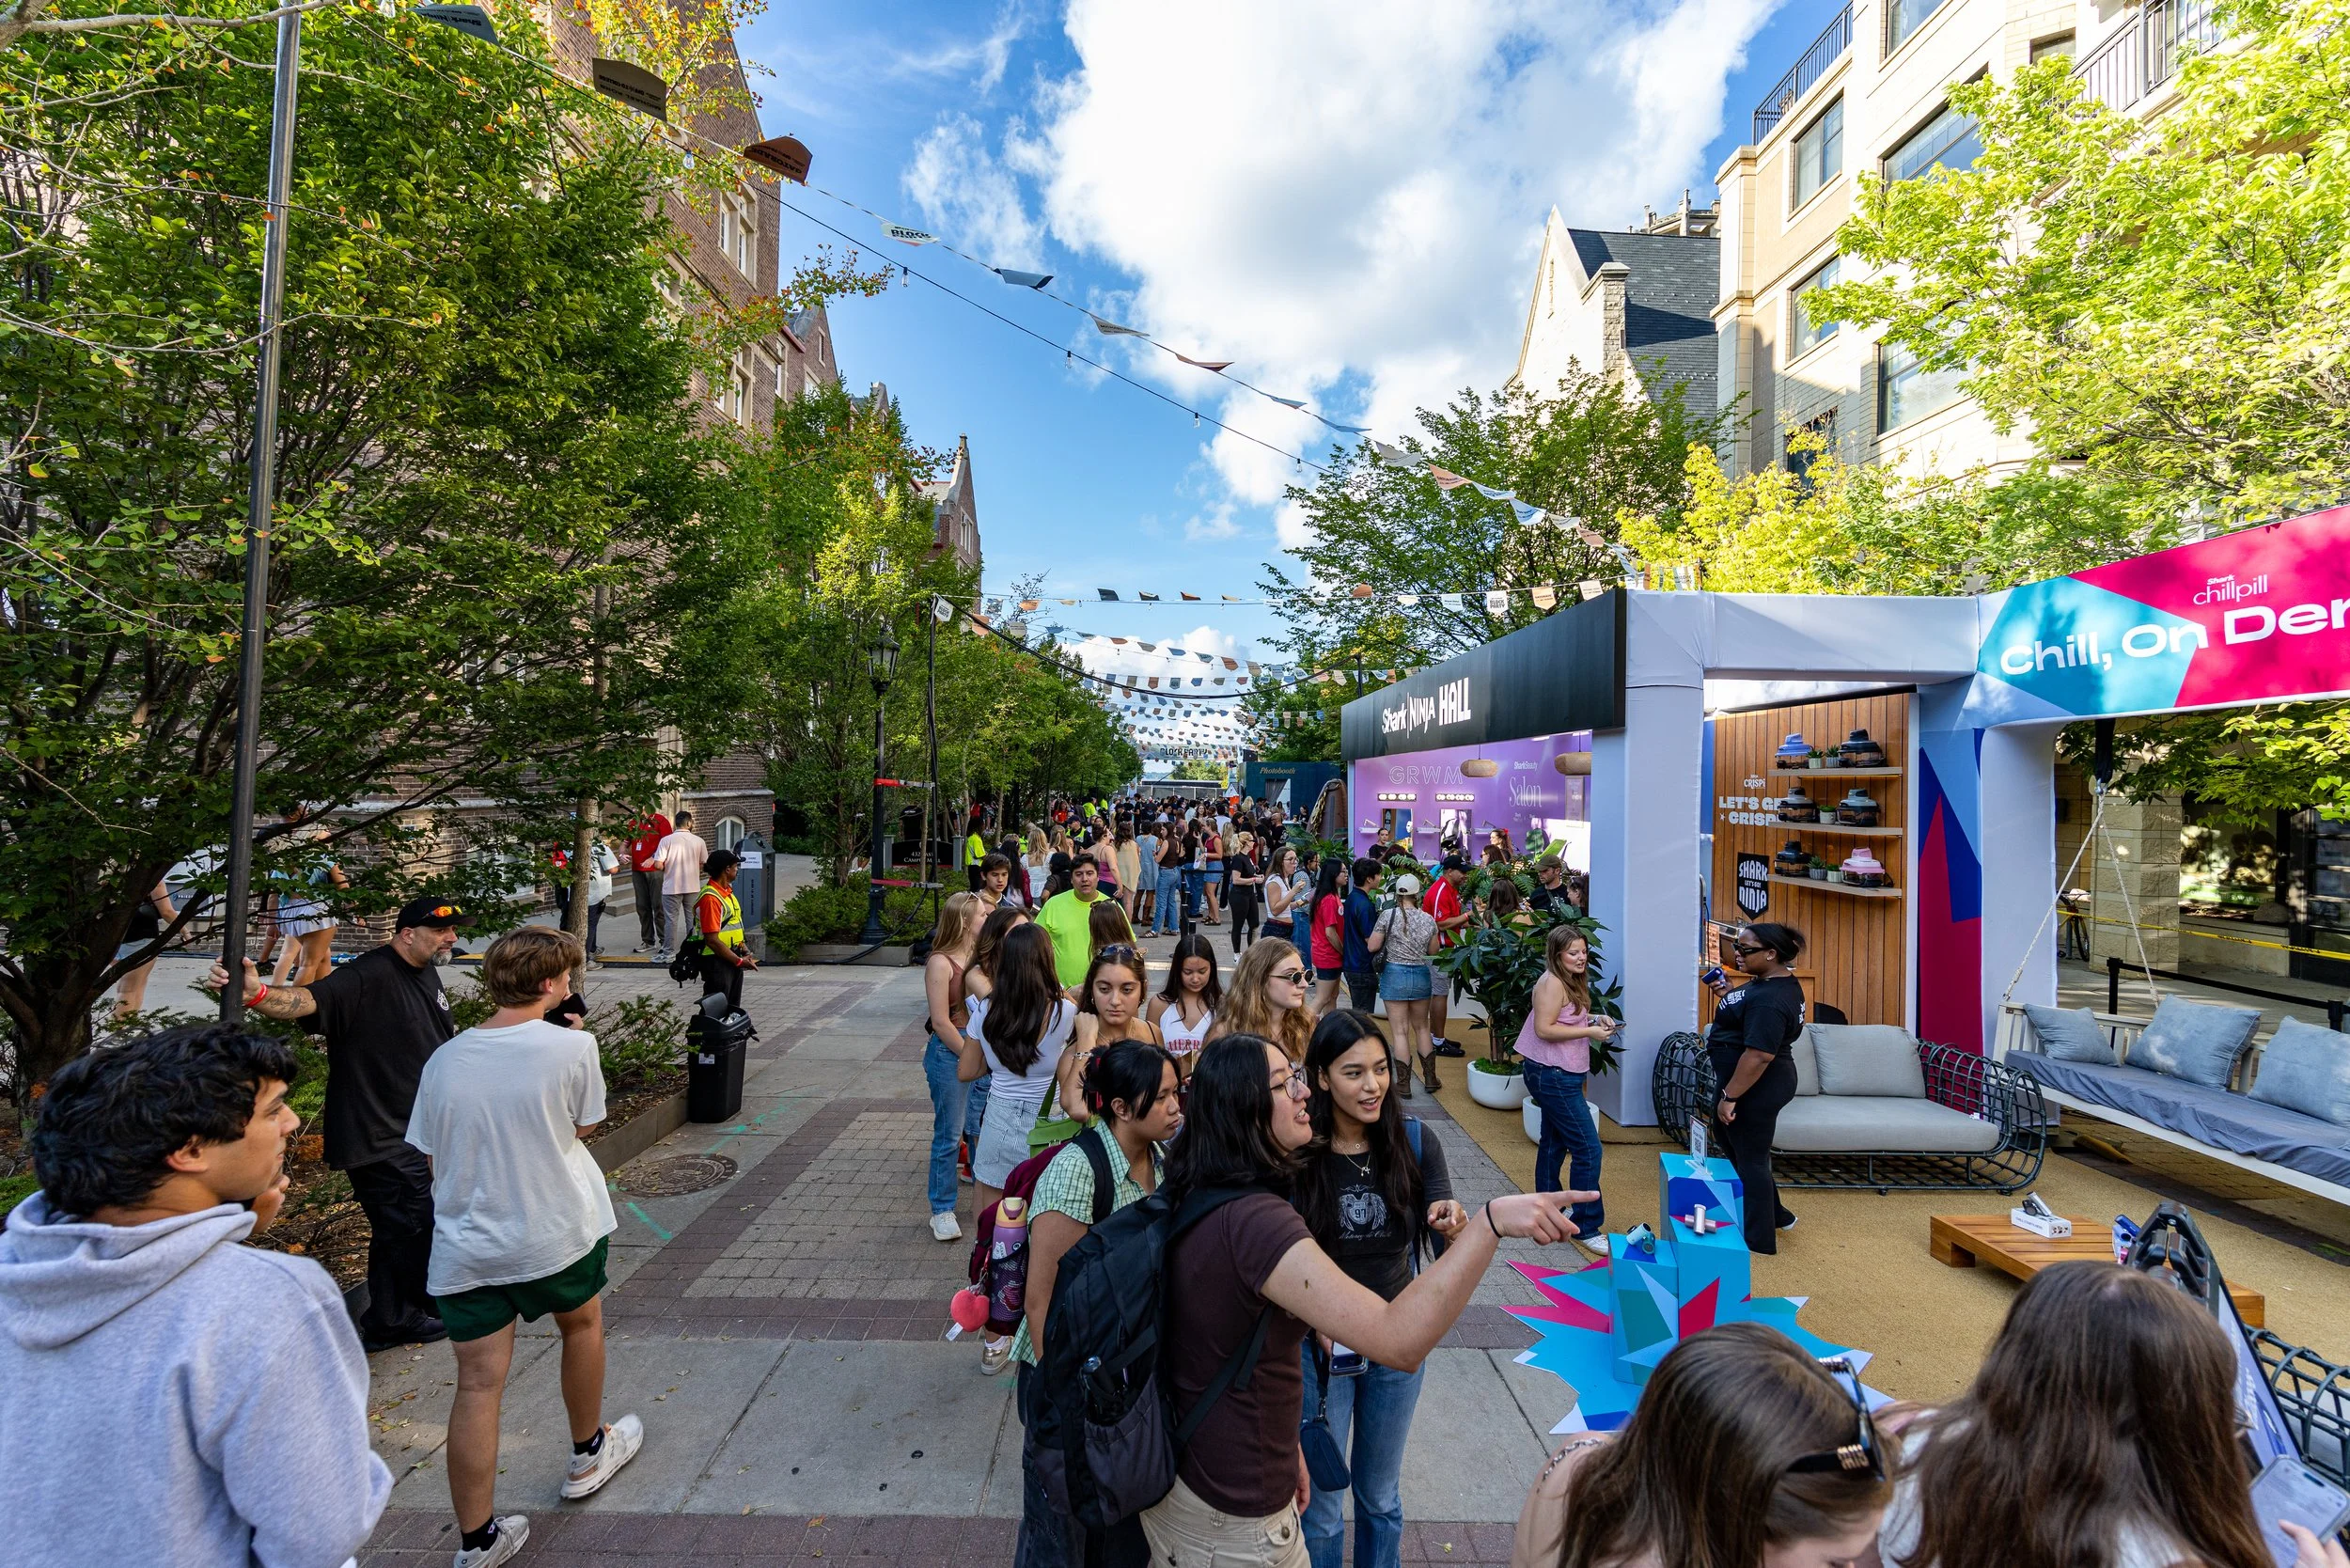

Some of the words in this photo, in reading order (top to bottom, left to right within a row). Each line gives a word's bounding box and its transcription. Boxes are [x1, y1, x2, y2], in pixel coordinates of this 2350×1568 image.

[749, 147, 803, 174] GATORADE
[2193, 574, 2268, 605] chillpill
[2207, 574, 2235, 586] Shark
[2000, 631, 2113, 676] Chill,
[2122, 622, 2209, 659] On
[1438, 677, 1472, 727] HALL
[1259, 766, 1296, 775] Photobooth
[1389, 765, 1464, 785] GRWM
[1509, 776, 1543, 808] Salon
[1718, 796, 1760, 810] LET'S
[1728, 811, 1780, 826] CRISP
[1738, 859, 1768, 882] SHARK
[1739, 886, 1767, 914] NINJA
[1355, 1208, 1367, 1219] 97
